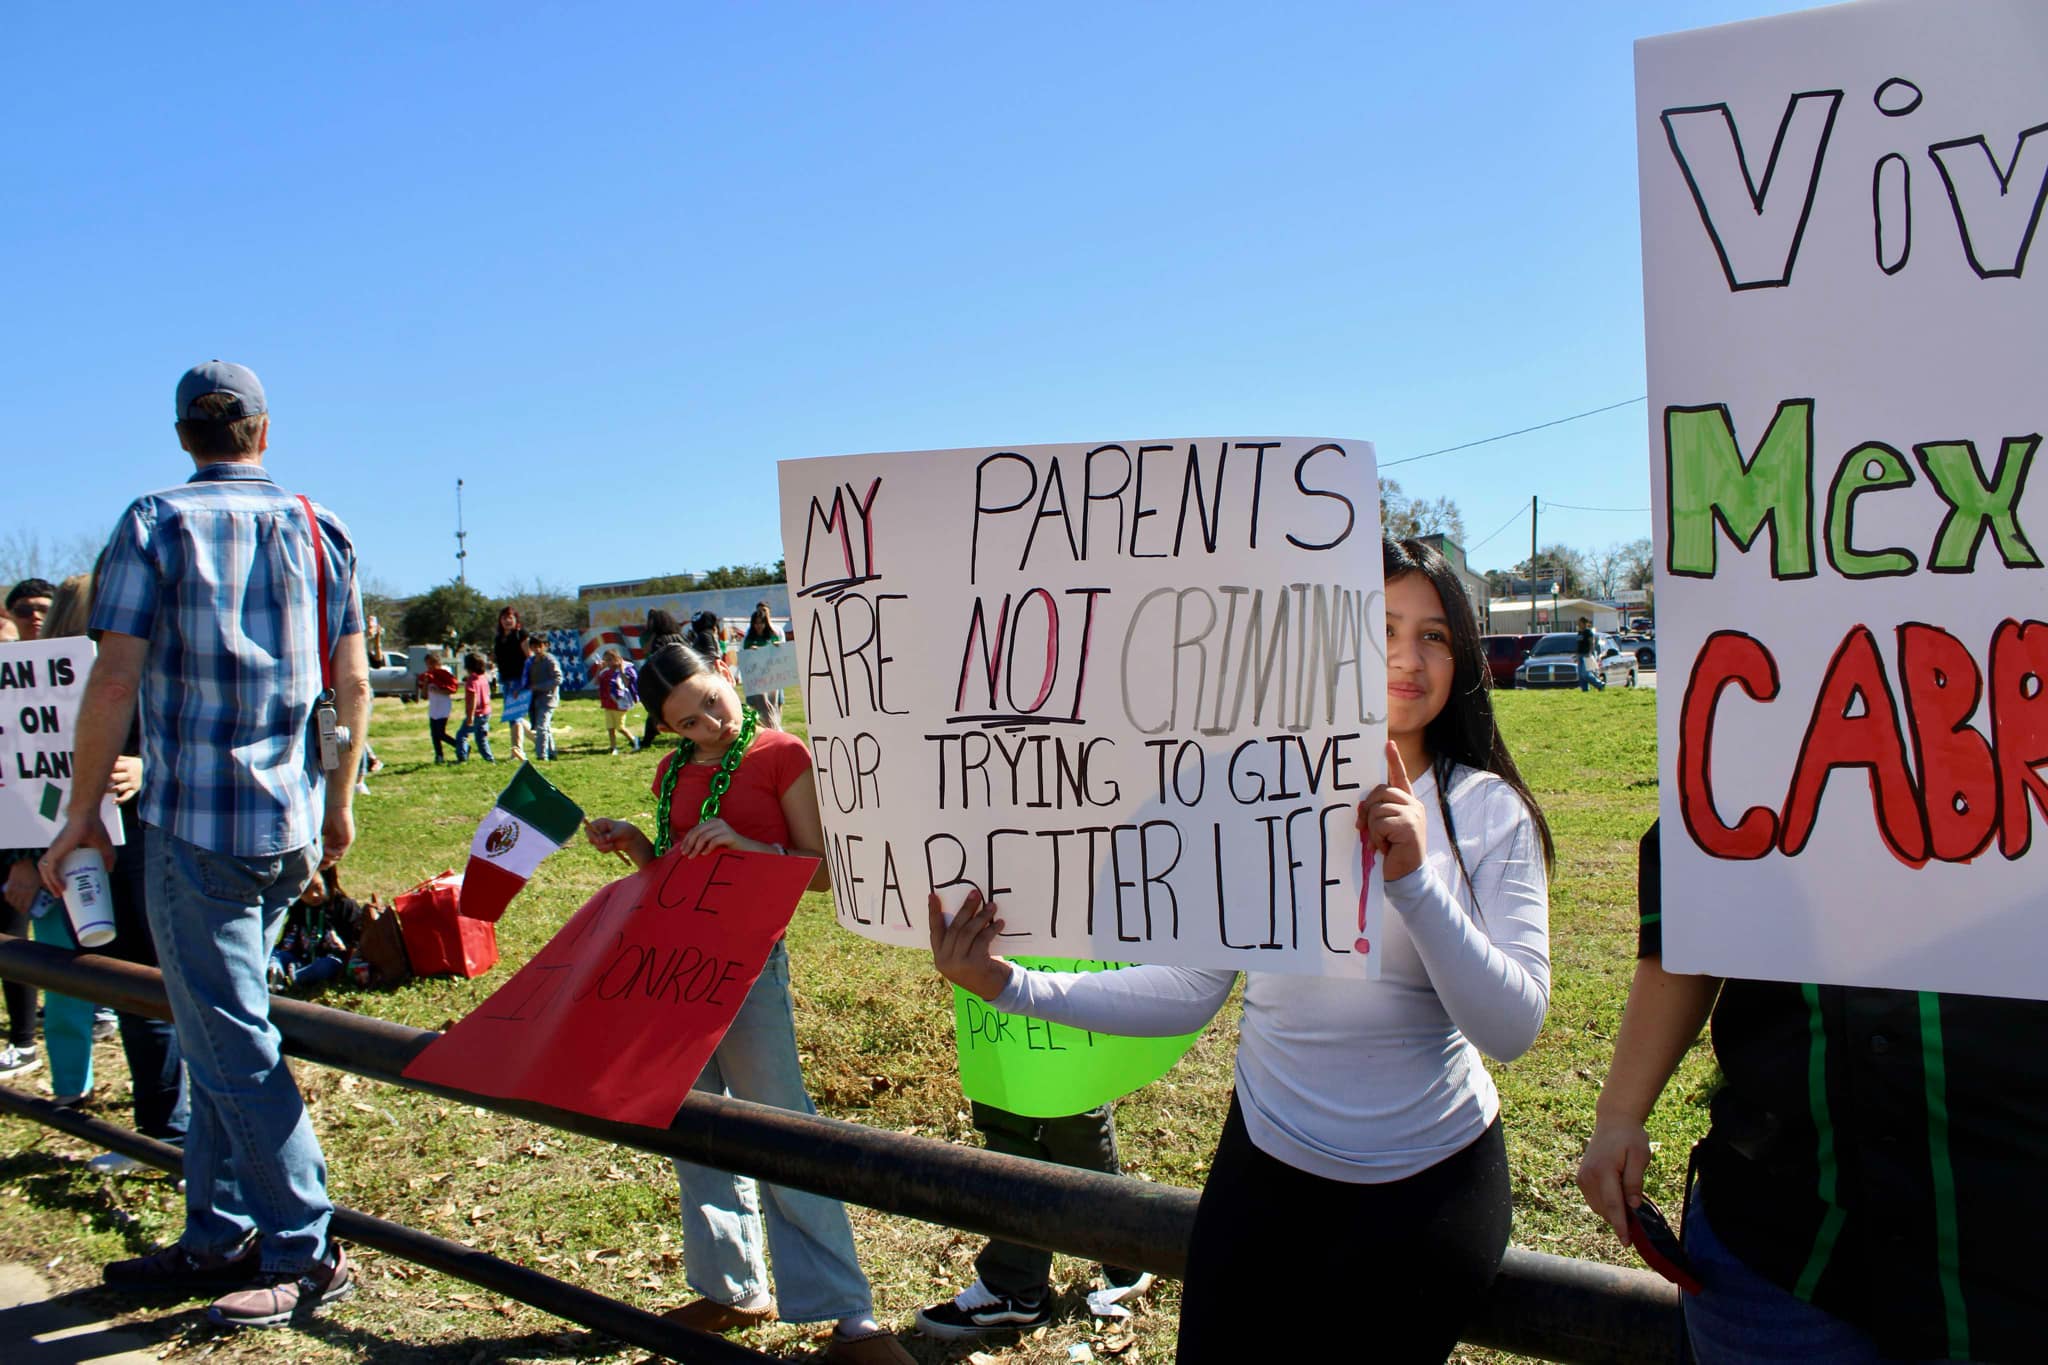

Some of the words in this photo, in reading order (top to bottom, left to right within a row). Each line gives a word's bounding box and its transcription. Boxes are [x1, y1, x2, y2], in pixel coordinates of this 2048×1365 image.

[802, 477, 882, 588] MY
[971, 442, 1355, 584] PARENTS
[1664, 398, 2044, 579] Mex
[48, 657, 75, 687] IS
[808, 593, 909, 724] ARE
[954, 588, 1111, 720] NOT
[16, 751, 74, 779] LAN
[20, 705, 60, 734] ON
[811, 732, 881, 813] FOR
[925, 731, 1120, 809] TRYING
[1145, 738, 1205, 807] TO
[1228, 733, 1360, 801] GIVE
[881, 840, 912, 928] A
[925, 820, 1182, 941] BETTER
